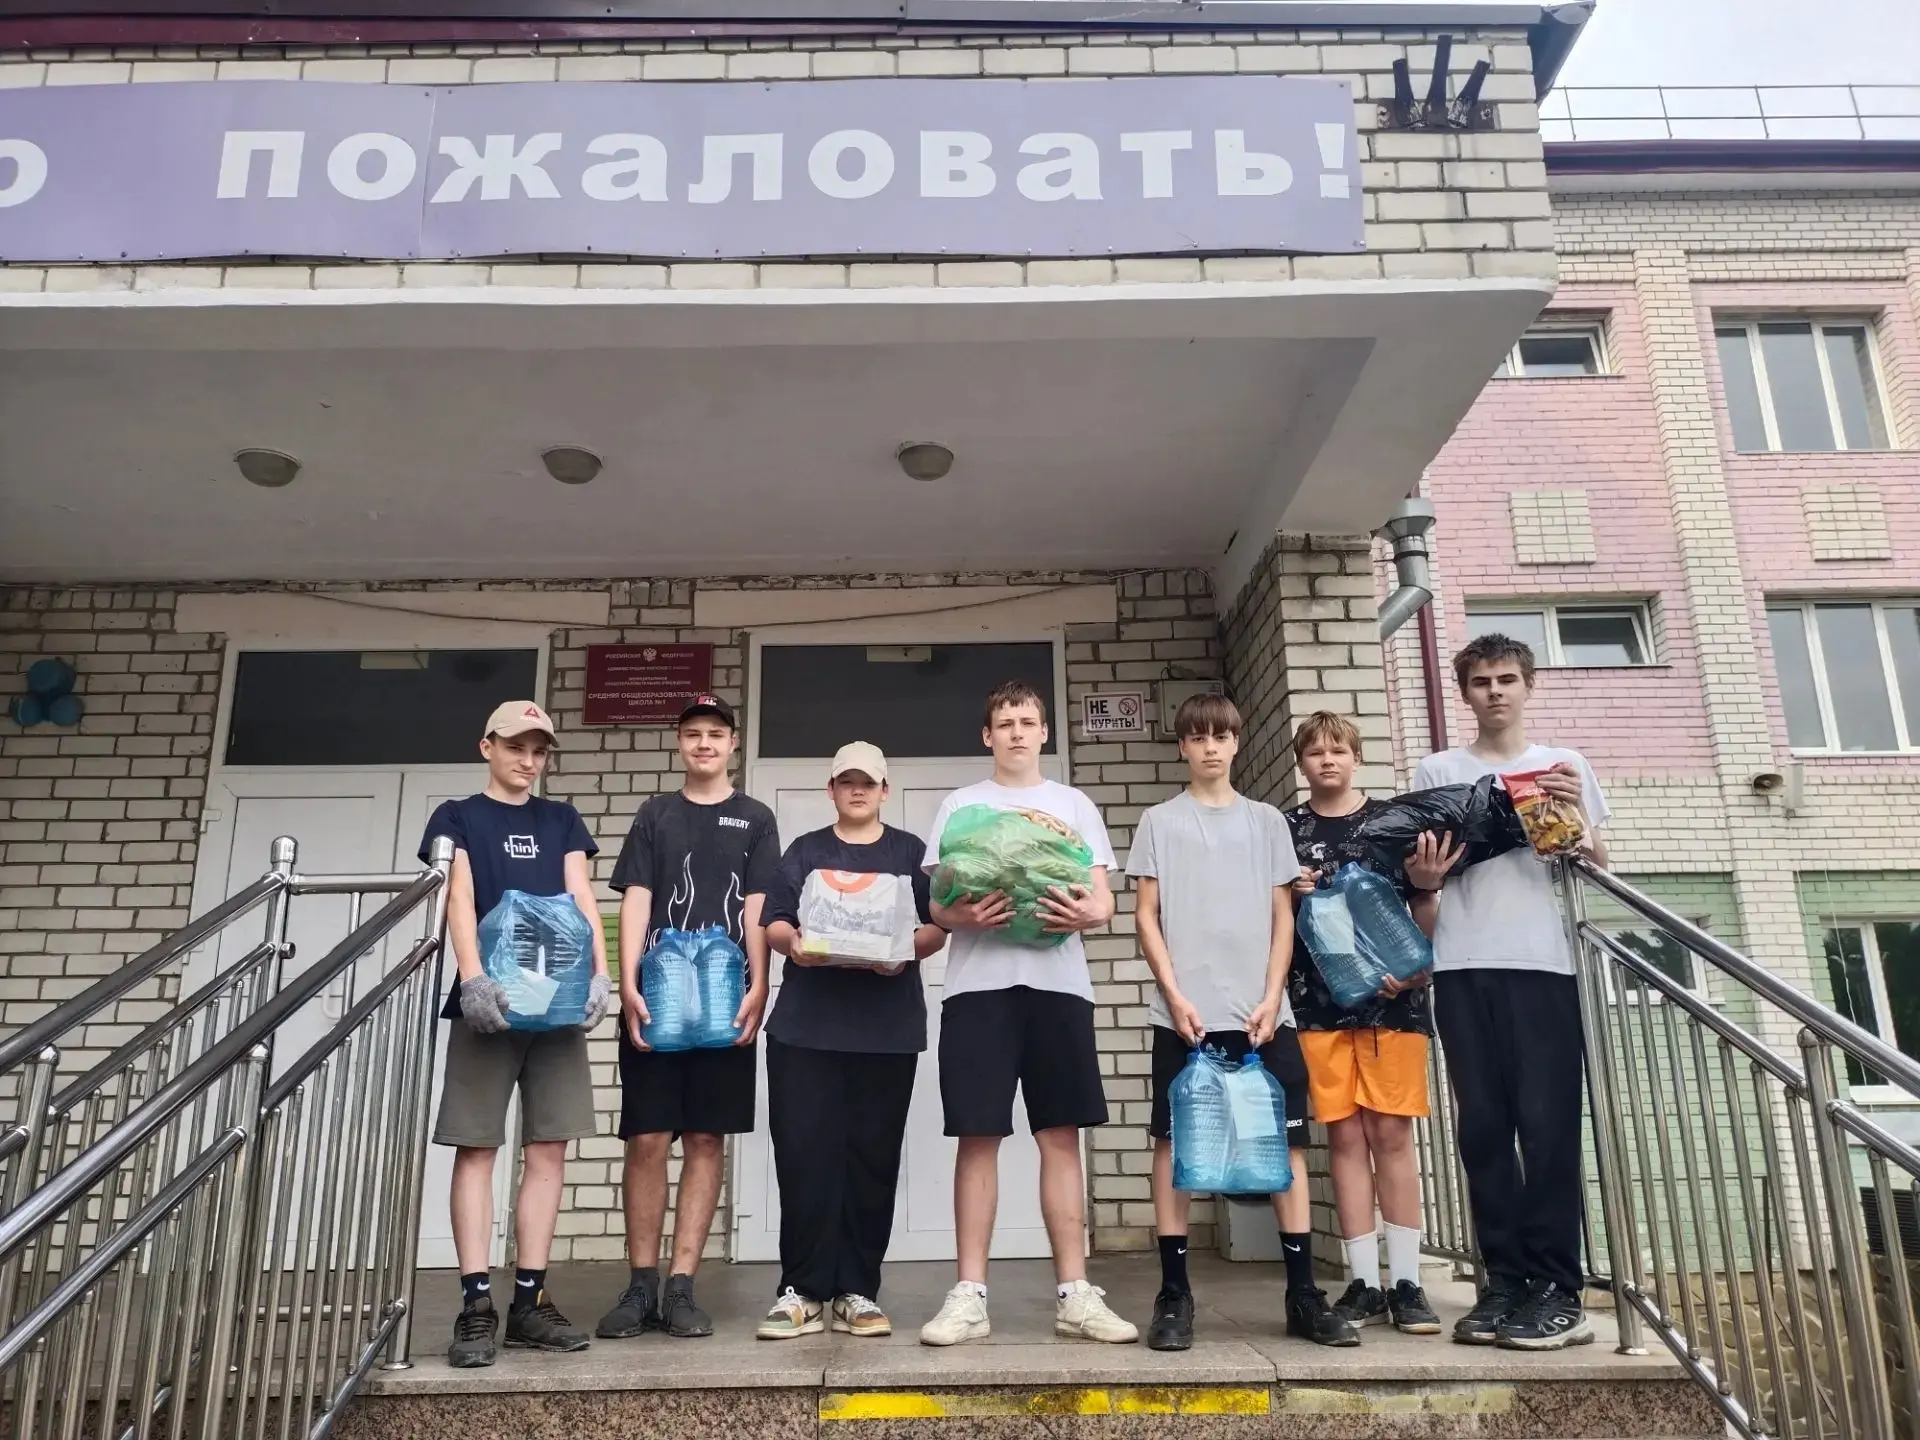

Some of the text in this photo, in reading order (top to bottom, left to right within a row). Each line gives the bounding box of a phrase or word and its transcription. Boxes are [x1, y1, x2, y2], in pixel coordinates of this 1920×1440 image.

[216, 121, 1351, 206] пожаловать!
[1090, 700, 1108, 714] НЕ
[719, 816, 750, 830] BRAVERY
[504, 837, 540, 855] think
